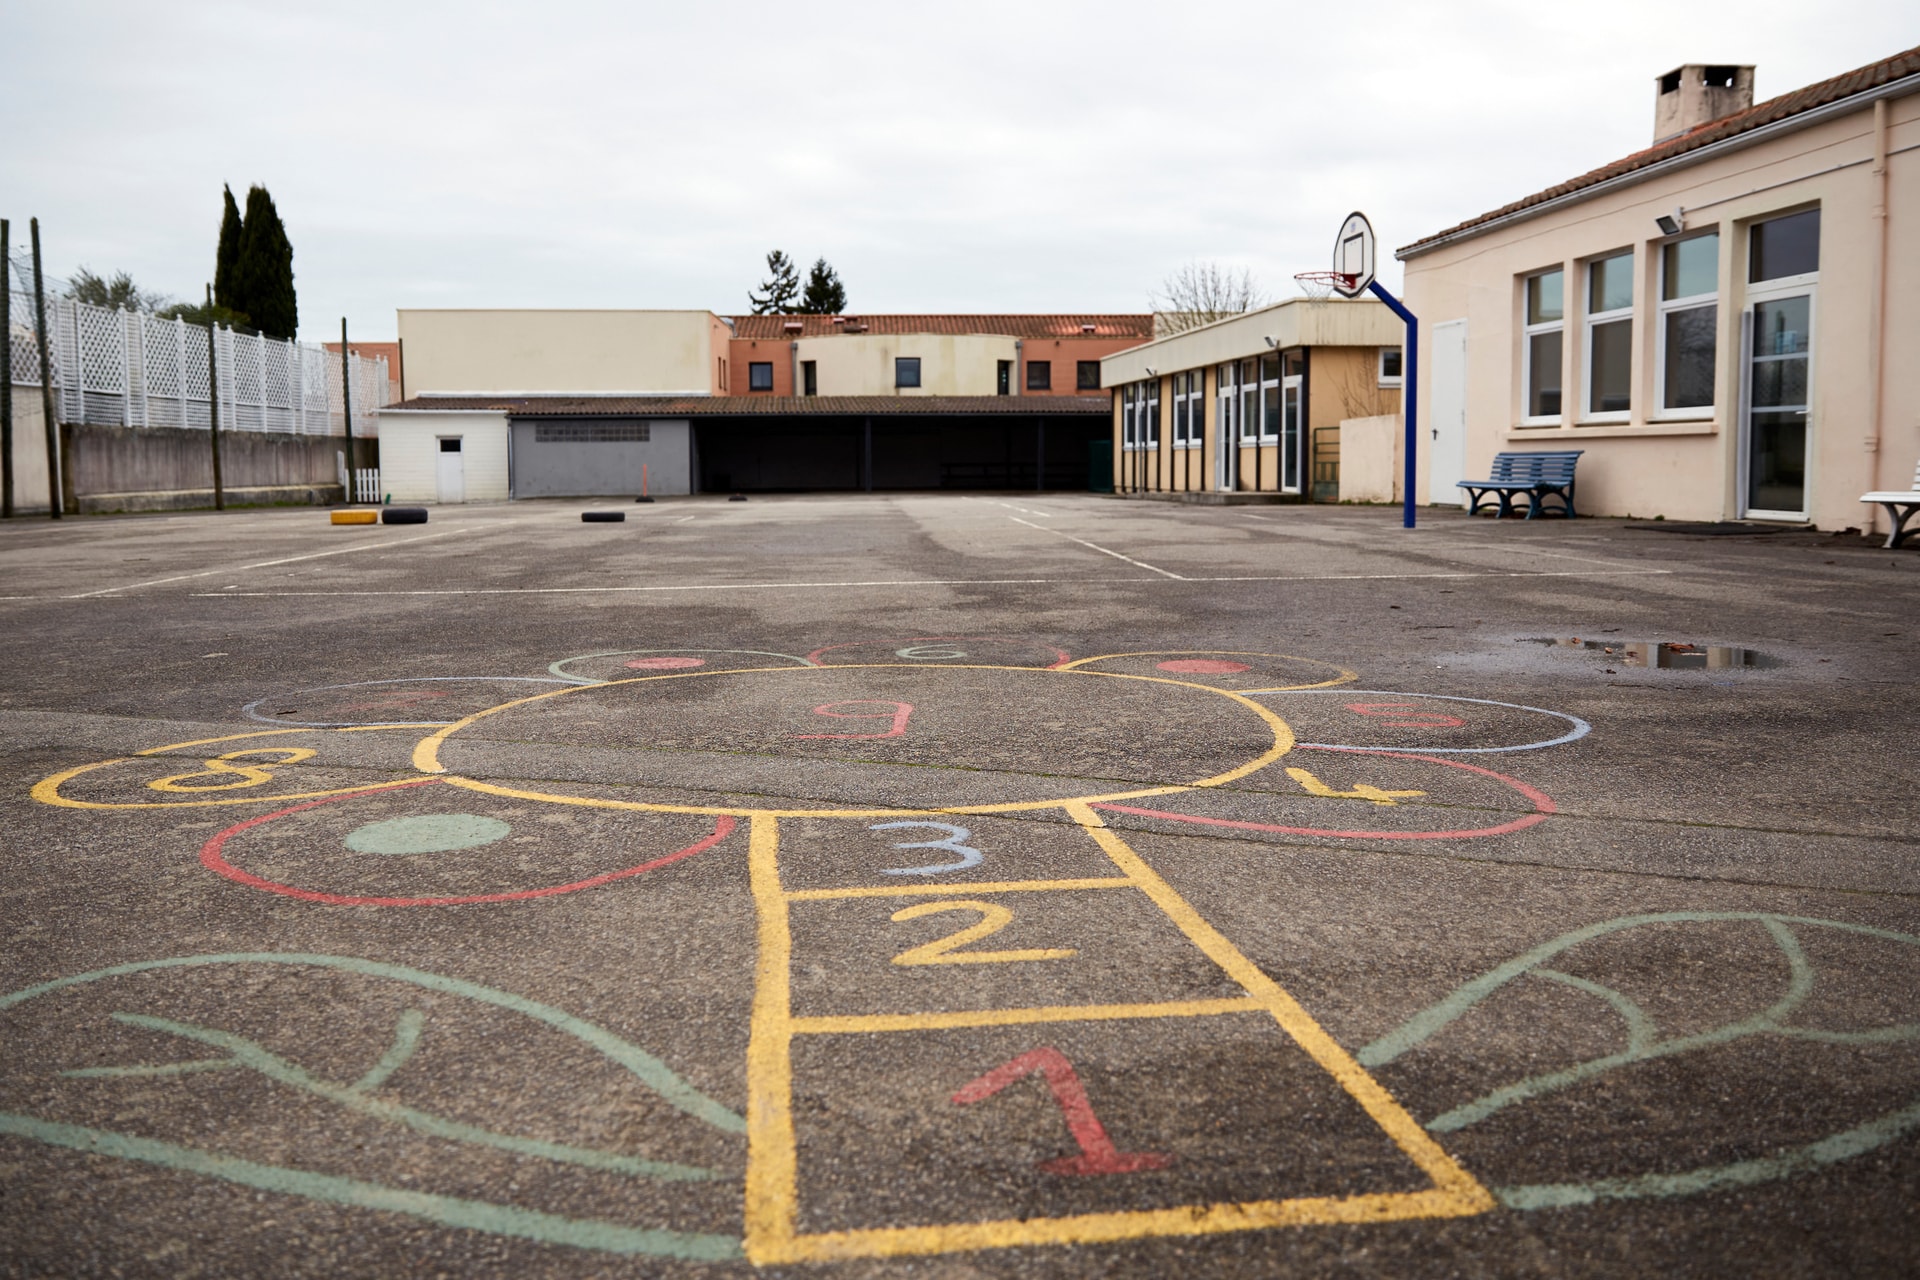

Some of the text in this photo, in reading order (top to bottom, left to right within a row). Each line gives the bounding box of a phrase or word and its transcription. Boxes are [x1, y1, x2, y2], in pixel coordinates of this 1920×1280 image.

[895, 643, 967, 660] 6
[785, 699, 915, 739] 9
[146, 747, 318, 792] 8
[1284, 767, 1428, 806] 4
[868, 820, 984, 876] 3
[891, 899, 1079, 966] 2
[951, 1046, 1176, 1176] 1
